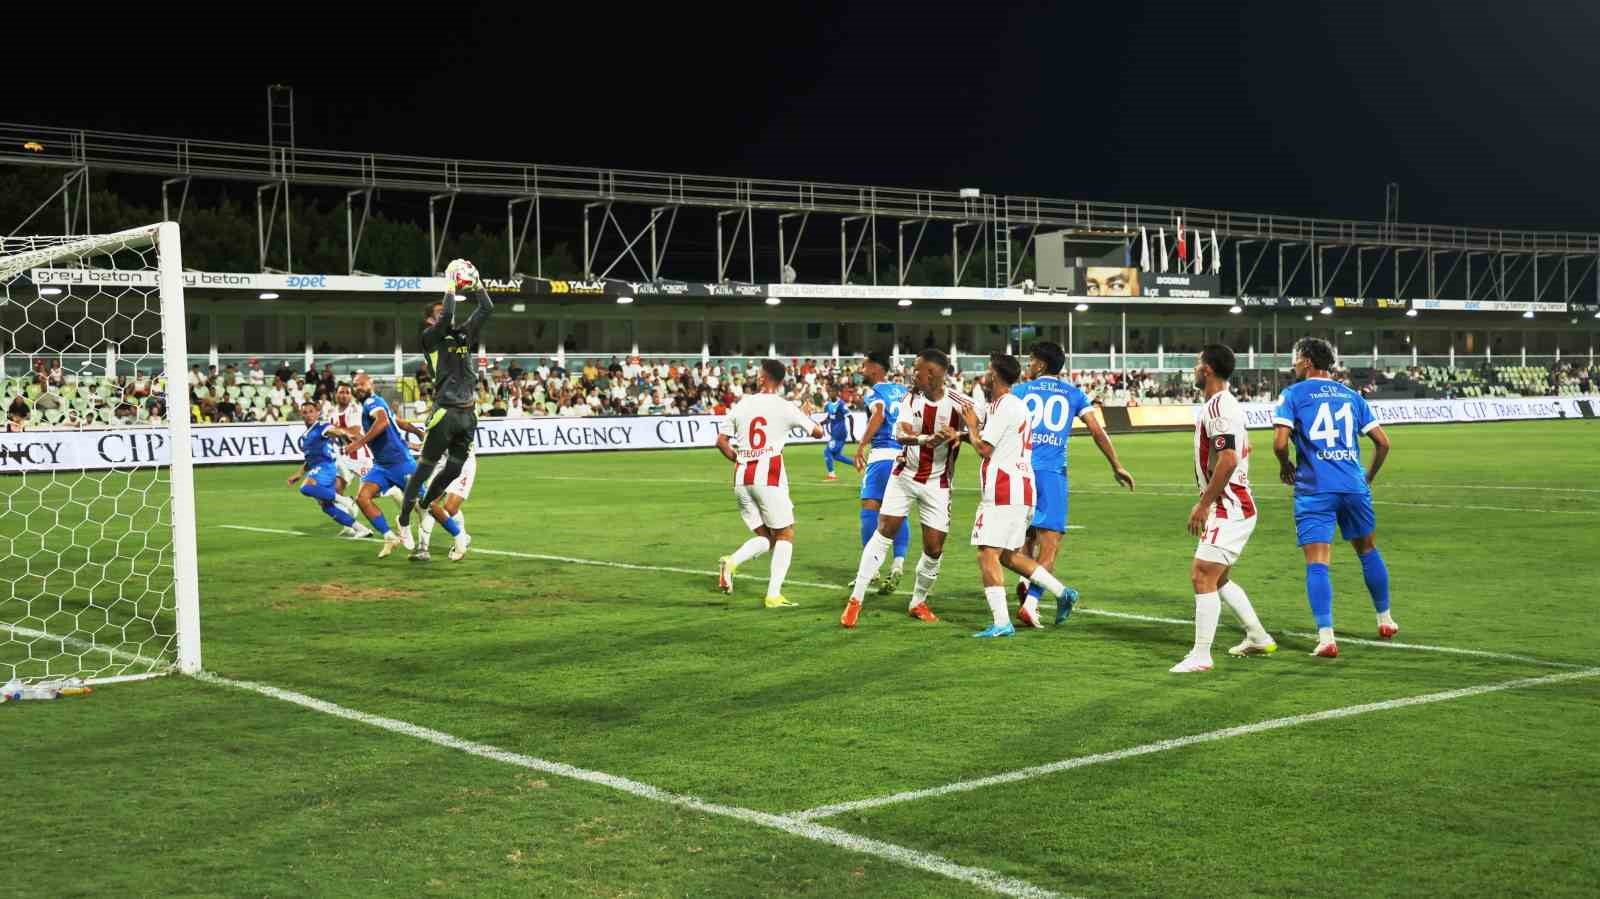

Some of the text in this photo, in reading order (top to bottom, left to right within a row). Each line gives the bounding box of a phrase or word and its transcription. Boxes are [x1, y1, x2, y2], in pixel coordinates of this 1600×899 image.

[88, 269, 142, 282] beton
[201, 272, 250, 284] beton
[483, 279, 523, 288] TALAY
[568, 281, 606, 289] TALAY
[1024, 393, 1069, 432] 90
[1309, 402, 1354, 448] 41
[474, 427, 549, 448] TRAVEL
[554, 426, 632, 446] AGENCY
[656, 420, 700, 444] CIP
[750, 416, 768, 449] 6
[98, 433, 164, 463] CIP
